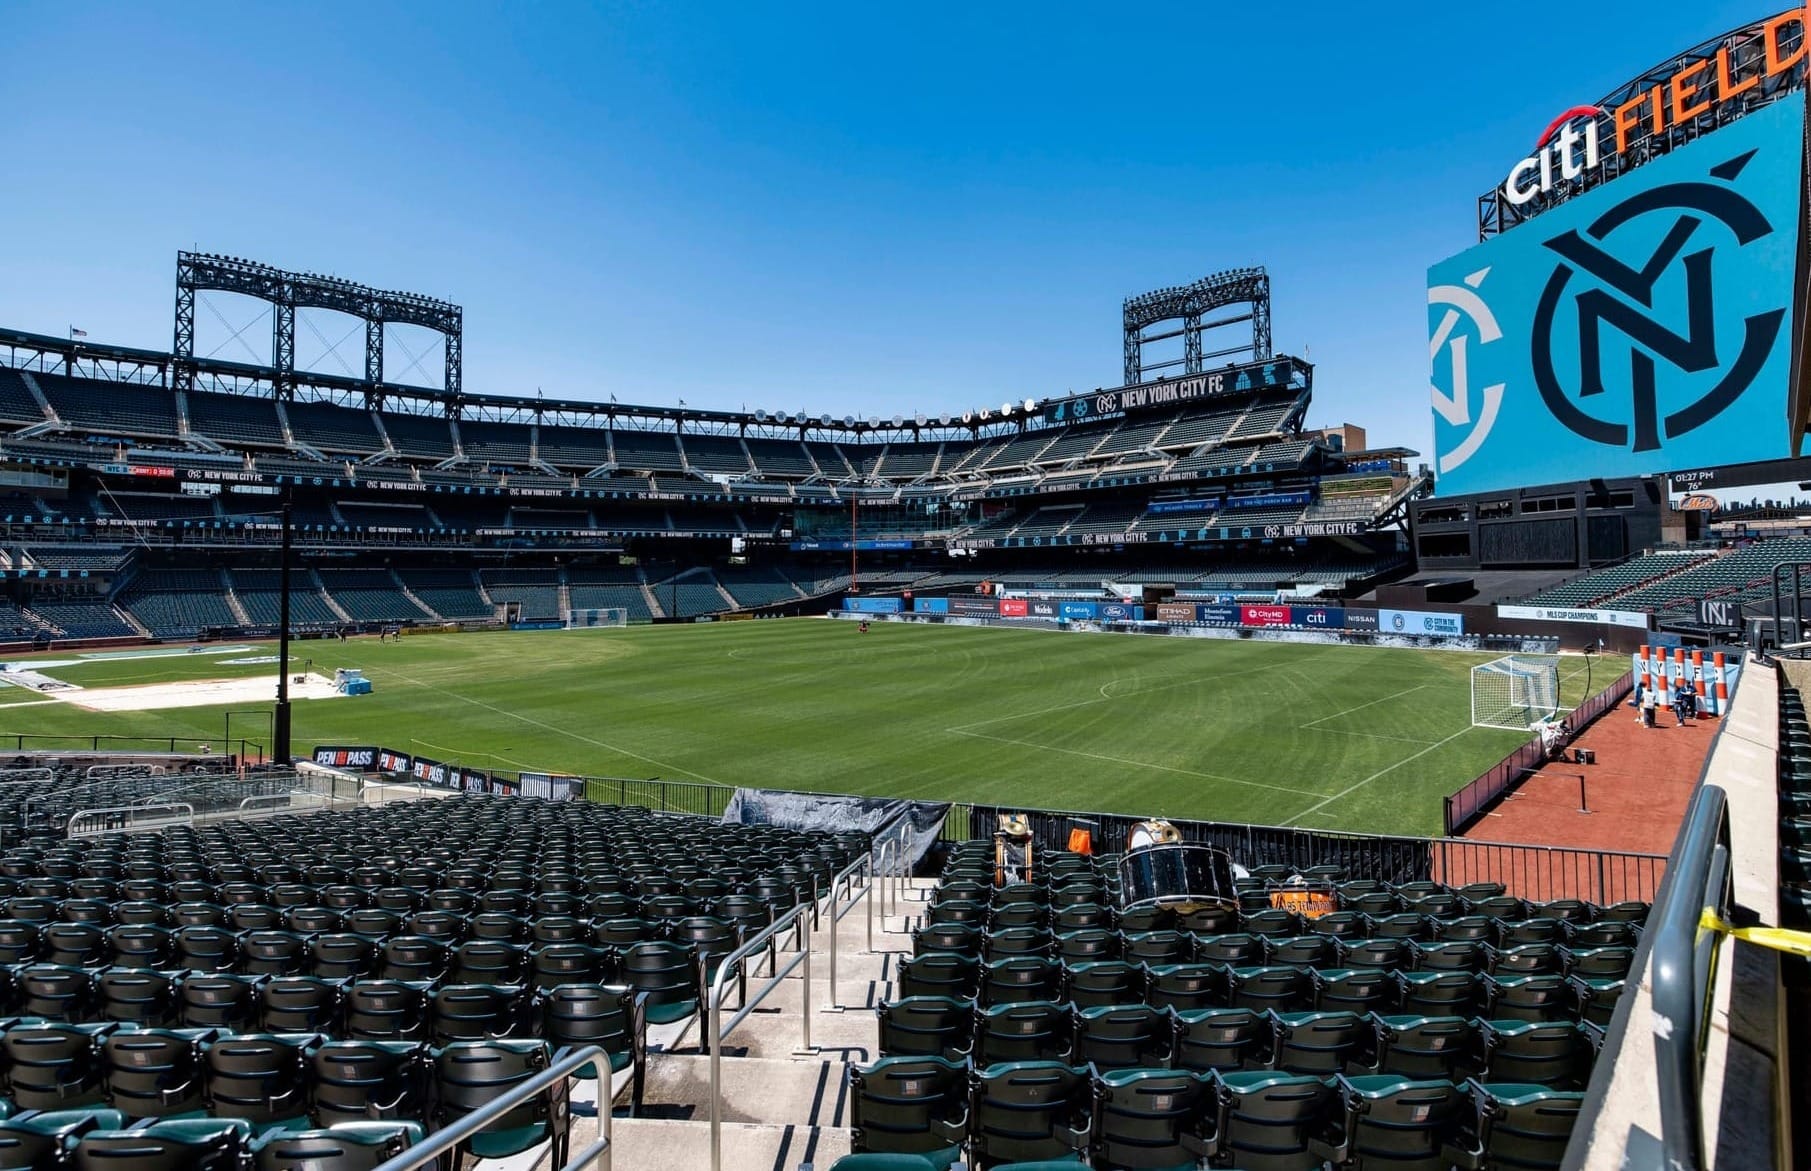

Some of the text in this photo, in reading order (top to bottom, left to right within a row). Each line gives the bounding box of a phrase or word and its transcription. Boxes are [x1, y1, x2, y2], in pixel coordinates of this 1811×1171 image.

[1506, 8, 1809, 205] citi FIELD
[1122, 375, 1224, 409] NEW YORK CITY FC
[205, 471, 263, 482] NEW YORK CITY FC
[1676, 472, 1714, 482] 01:27 PM
[1284, 522, 1358, 536] NEW YORK CITY FC
[1096, 532, 1148, 543] NEW YORK CITY FC
[1258, 610, 1283, 619] CityMD
[1306, 612, 1326, 624] citi
[1547, 610, 1558, 618] MLS
[1568, 612, 1598, 620] CHAMPIONS
[316, 751, 336, 765] PEN
[347, 751, 372, 766] PASS
[392, 756, 407, 772] PASS
[428, 766, 444, 784] PASS
